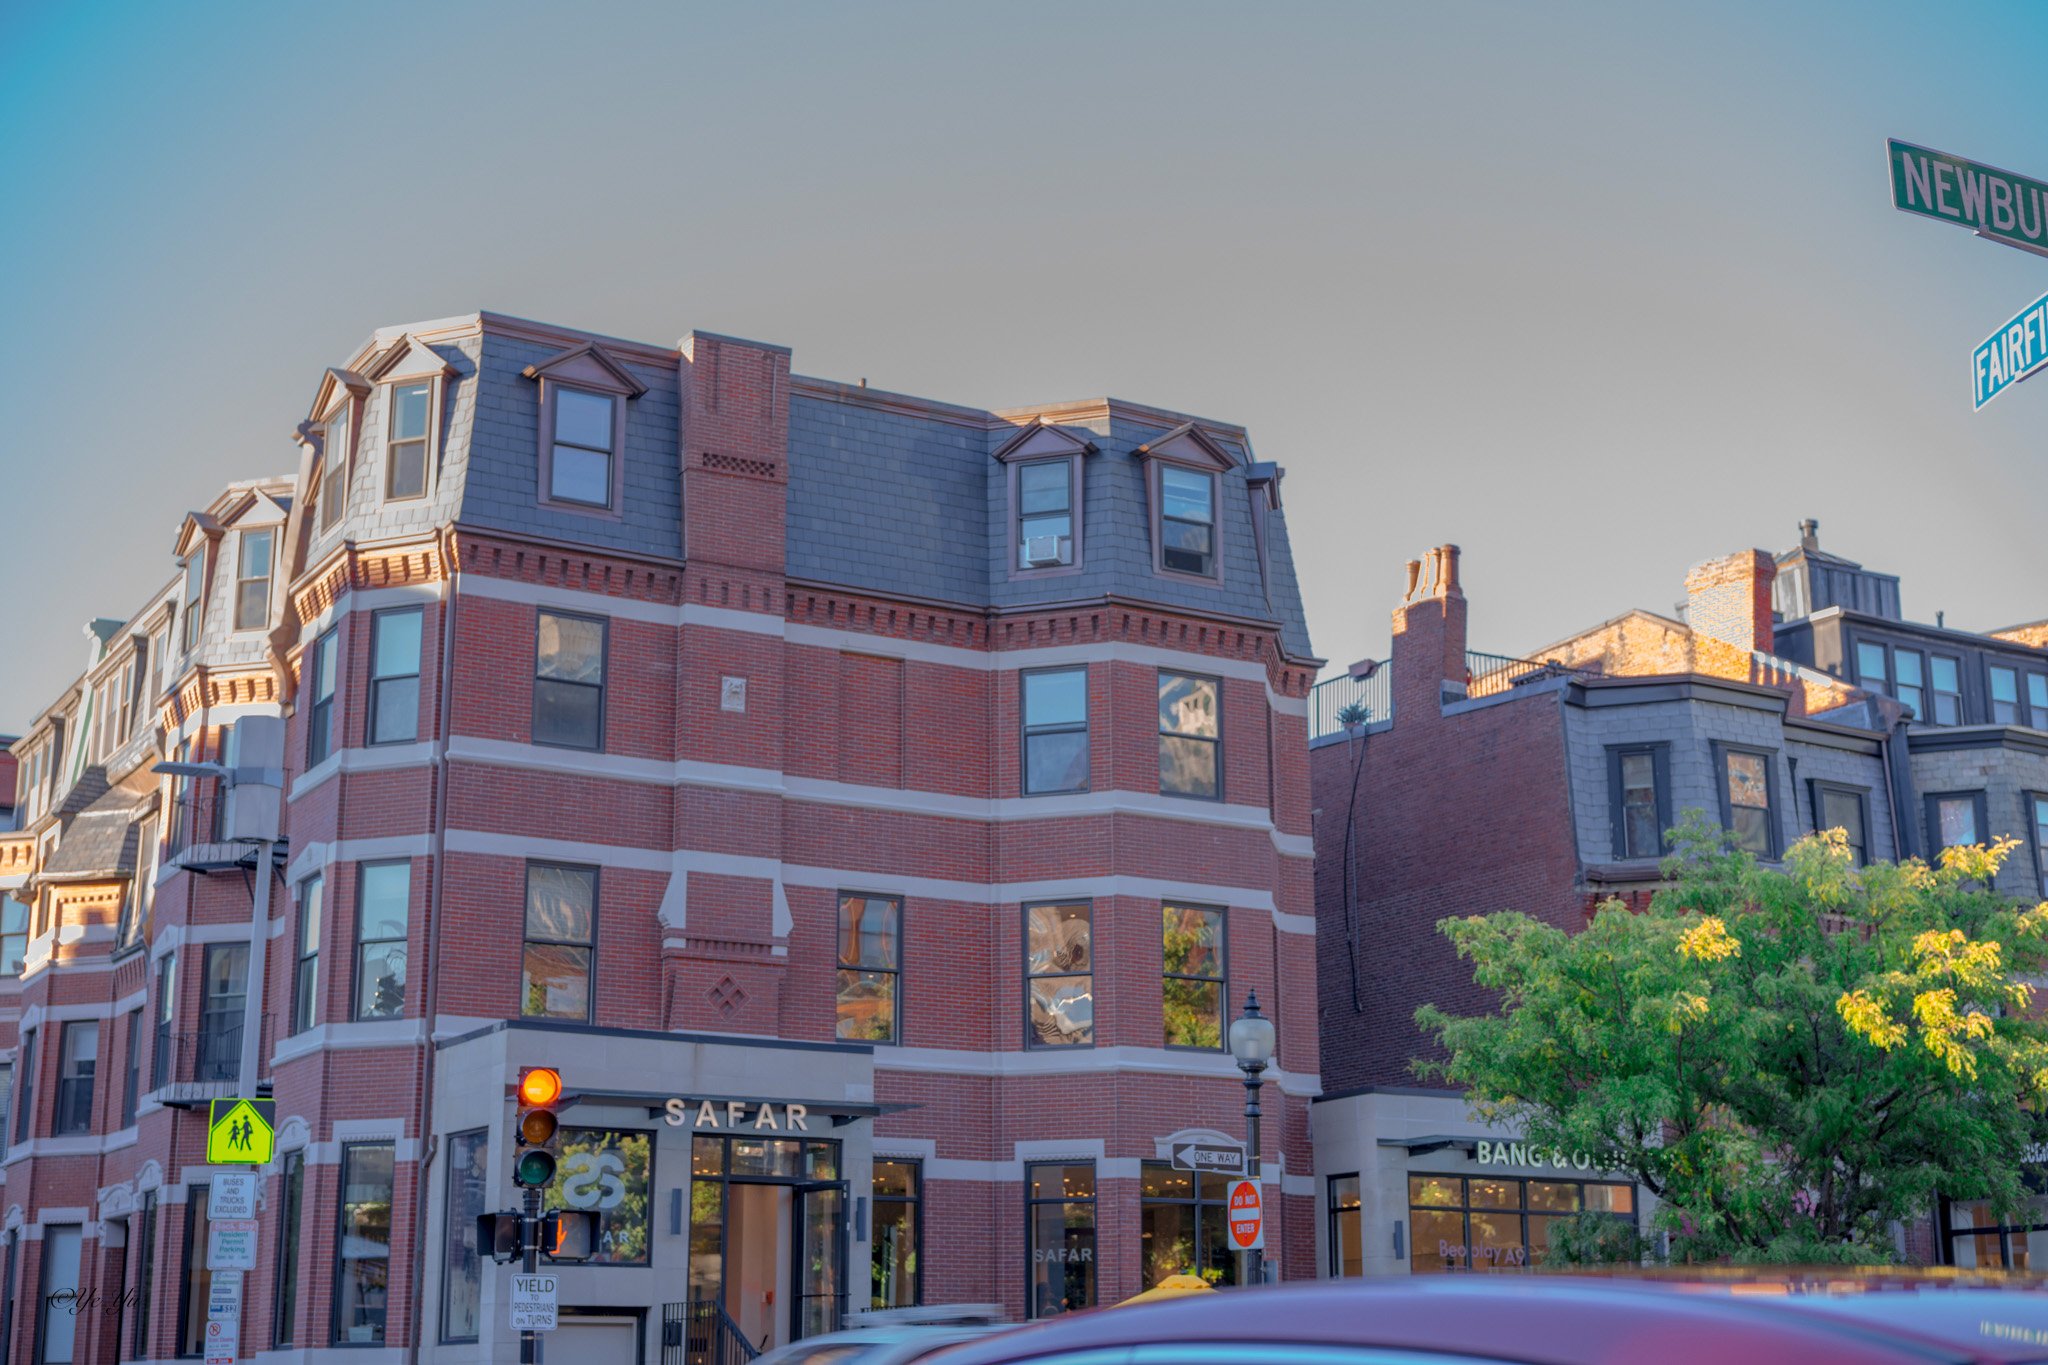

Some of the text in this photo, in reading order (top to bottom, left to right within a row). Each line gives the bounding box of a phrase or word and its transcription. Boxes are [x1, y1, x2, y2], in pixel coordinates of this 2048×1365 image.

[1902, 151, 2048, 240] NEWBU
[1975, 300, 2048, 402] FAIRFI
[664, 1098, 808, 1131] SAFAR
[1193, 1151, 1237, 1164] ONE WAY
[1477, 1141, 1543, 1168] BANG
[222, 1178, 245, 1187] BUSES
[220, 1196, 245, 1205] TRUCKS
[1234, 1194, 1256, 1206] DO NOT
[214, 1205, 248, 1214] EXCLUDED
[1236, 1223, 1255, 1234] ENTER
[219, 1245, 246, 1254] Parking
[1035, 1248, 1093, 1262] SAFAR
[1504, 1247, 1525, 1265] A9
[516, 1279, 555, 1293] YIELD
[514, 1302, 555, 1312] PEDESTRIANS
[515, 1314, 553, 1325] ON TURNS
